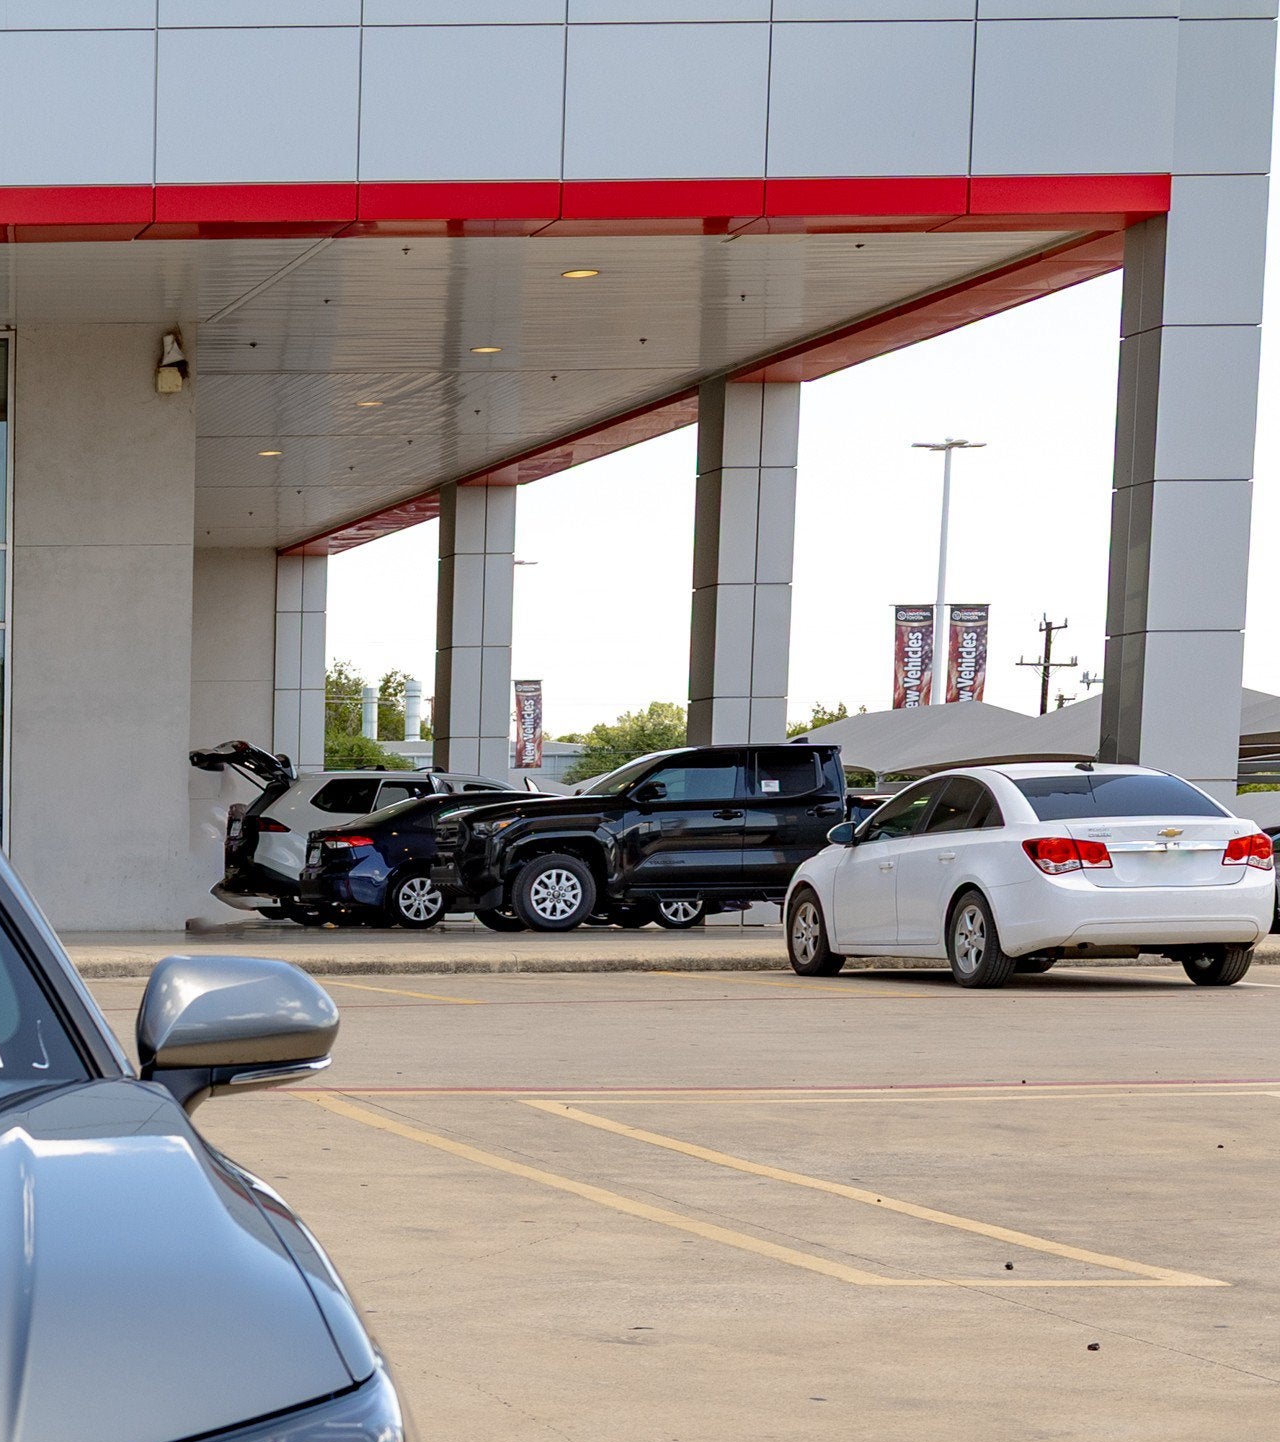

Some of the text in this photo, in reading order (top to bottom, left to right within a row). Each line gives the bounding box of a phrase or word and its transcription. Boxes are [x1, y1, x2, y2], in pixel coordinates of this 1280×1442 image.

[903, 632, 922, 688] Vehicles
[957, 632, 977, 688] Vehicles
[522, 699, 535, 740] Vehicles
[905, 690, 920, 708] ew
[522, 742, 535, 763] New
